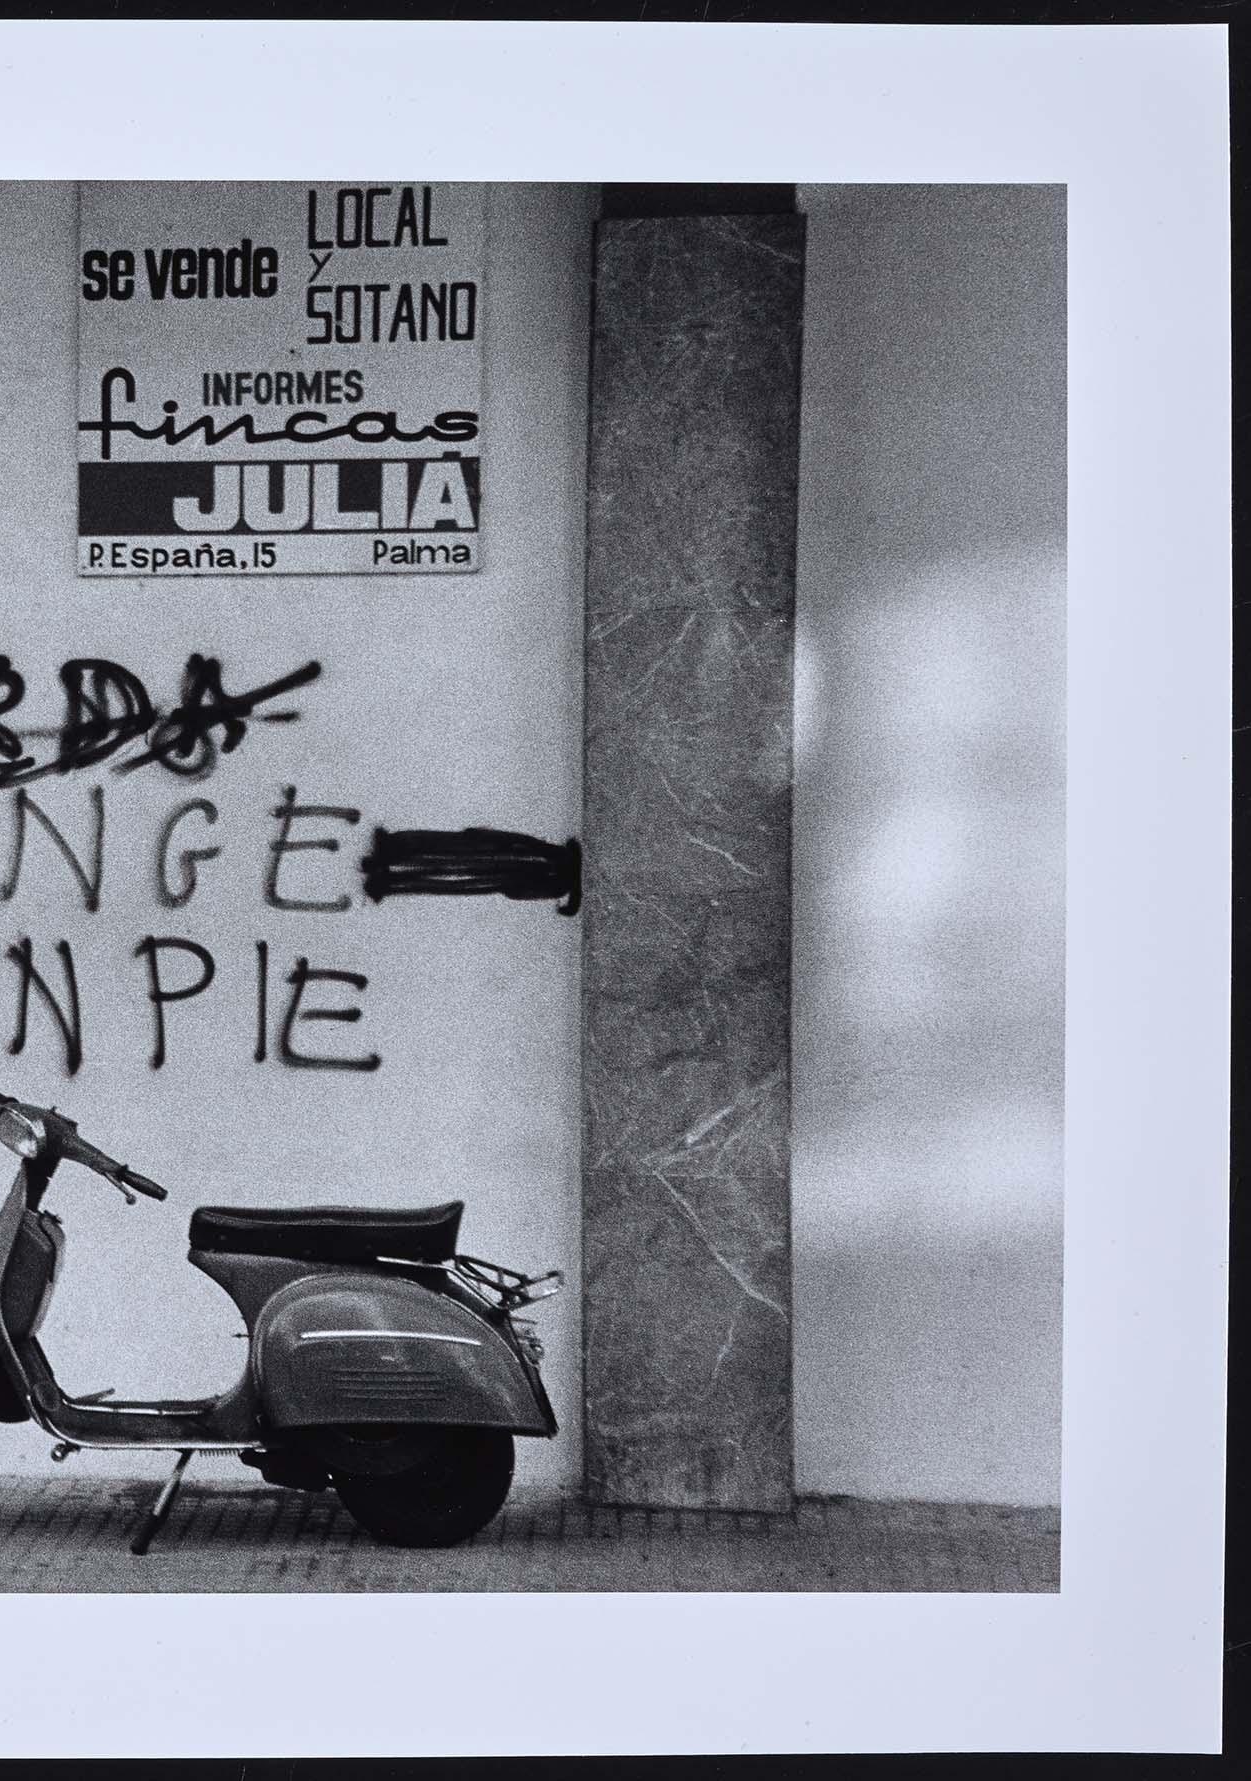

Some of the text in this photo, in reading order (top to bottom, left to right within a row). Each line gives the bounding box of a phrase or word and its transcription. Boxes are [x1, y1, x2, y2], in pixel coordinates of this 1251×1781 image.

[308, 186, 448, 250] LOCAL
[82, 238, 279, 301] se vende
[307, 282, 477, 344] SOTANO
[78, 366, 479, 460] fincas
[202, 369, 364, 406] INFORMES
[373, 539, 471, 565] Palma
[134, 936, 382, 1072] PIE
